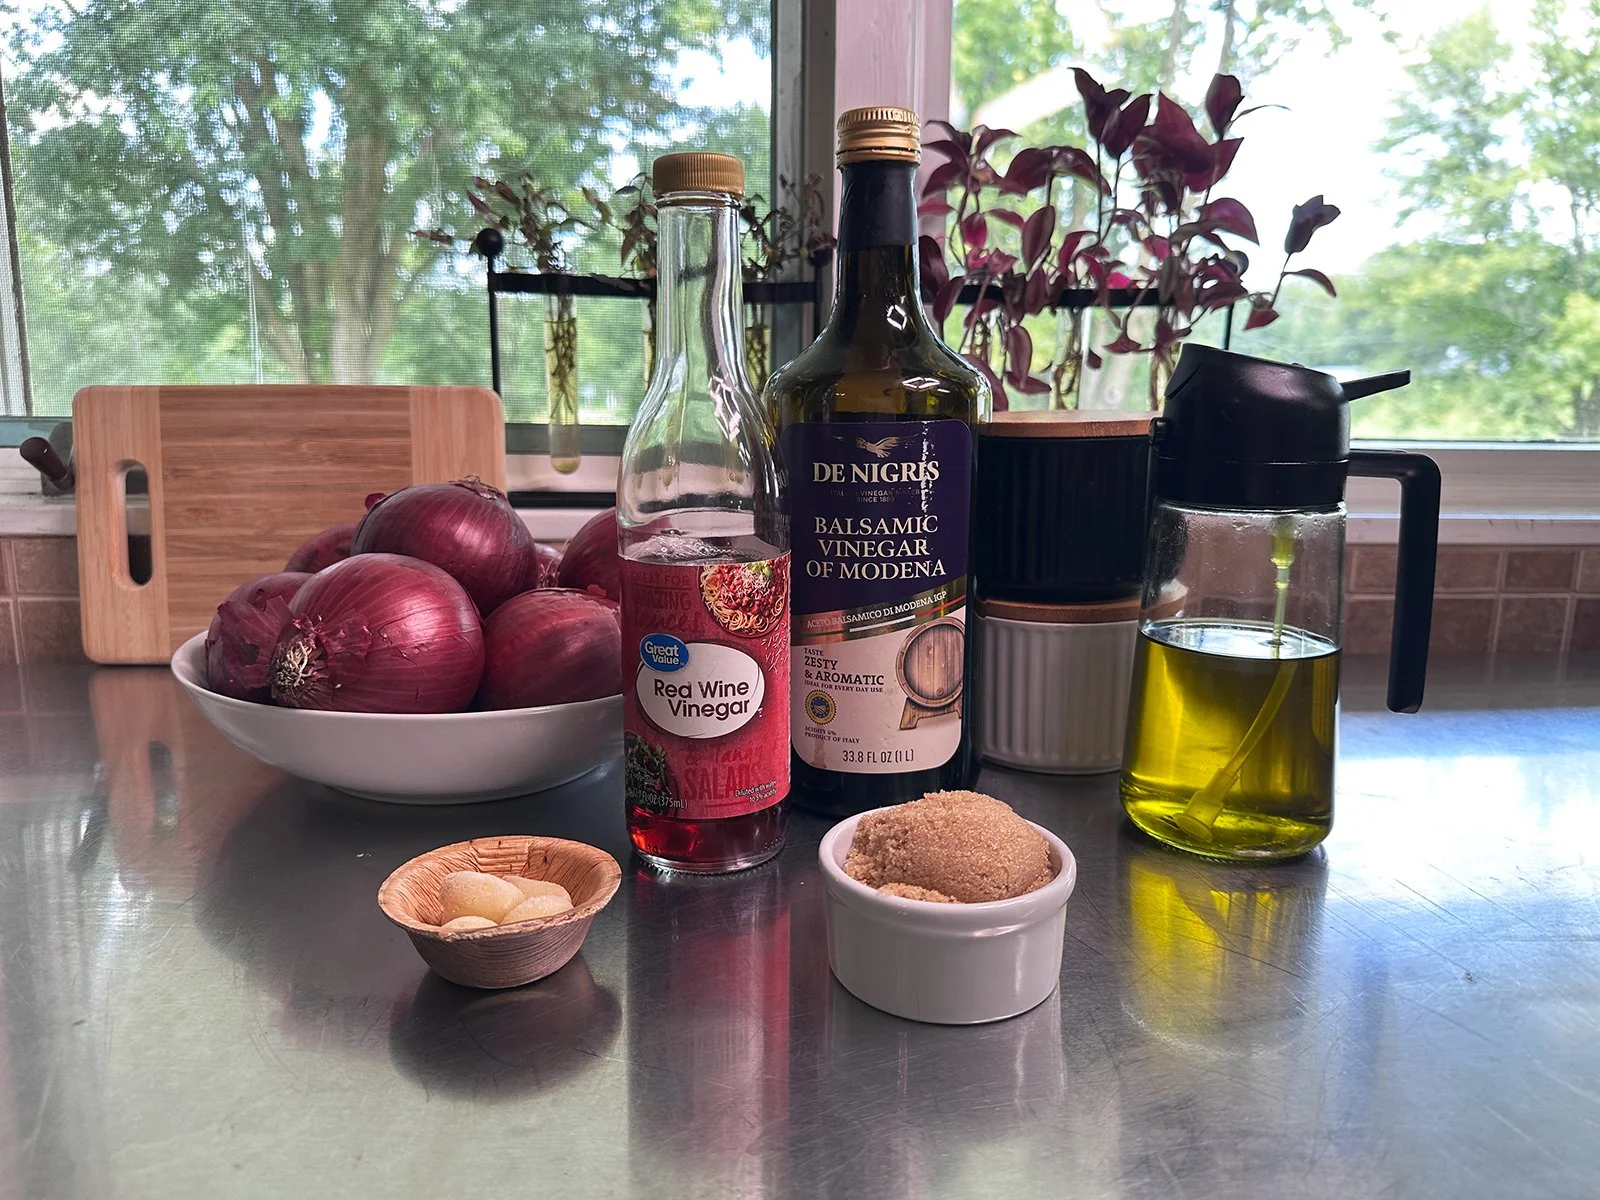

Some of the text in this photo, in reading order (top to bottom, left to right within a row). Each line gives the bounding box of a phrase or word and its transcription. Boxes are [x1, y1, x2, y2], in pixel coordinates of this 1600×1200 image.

[813, 462, 845, 482] DE
[850, 460, 940, 483] NIGRIS
[814, 516, 938, 536] BALSAMIC
[818, 539, 930, 558] VINEGAR
[806, 559, 946, 581] OF MODENA
[664, 575, 690, 587] FOR
[807, 590, 947, 629] ACETO BALSAMICO DI MODENA IGP
[644, 641, 680, 657] Great
[804, 648, 824, 657] TASTE
[652, 653, 680, 665] Value
[804, 656, 838, 671] ZESTY
[804, 669, 885, 686] & AROMATIC
[654, 679, 749, 699] Red Wine
[804, 680, 820, 688] IDEAL
[821, 682, 833, 690] FOR
[834, 684, 854, 692] EVERY
[668, 699, 750, 721] Vinegar
[805, 732, 831, 742] PRODUCT
[842, 750, 864, 763] 33.8
[867, 751, 877, 763] FL
[880, 751, 892, 763] OZ
[658, 795, 688, 809] (375mL)
